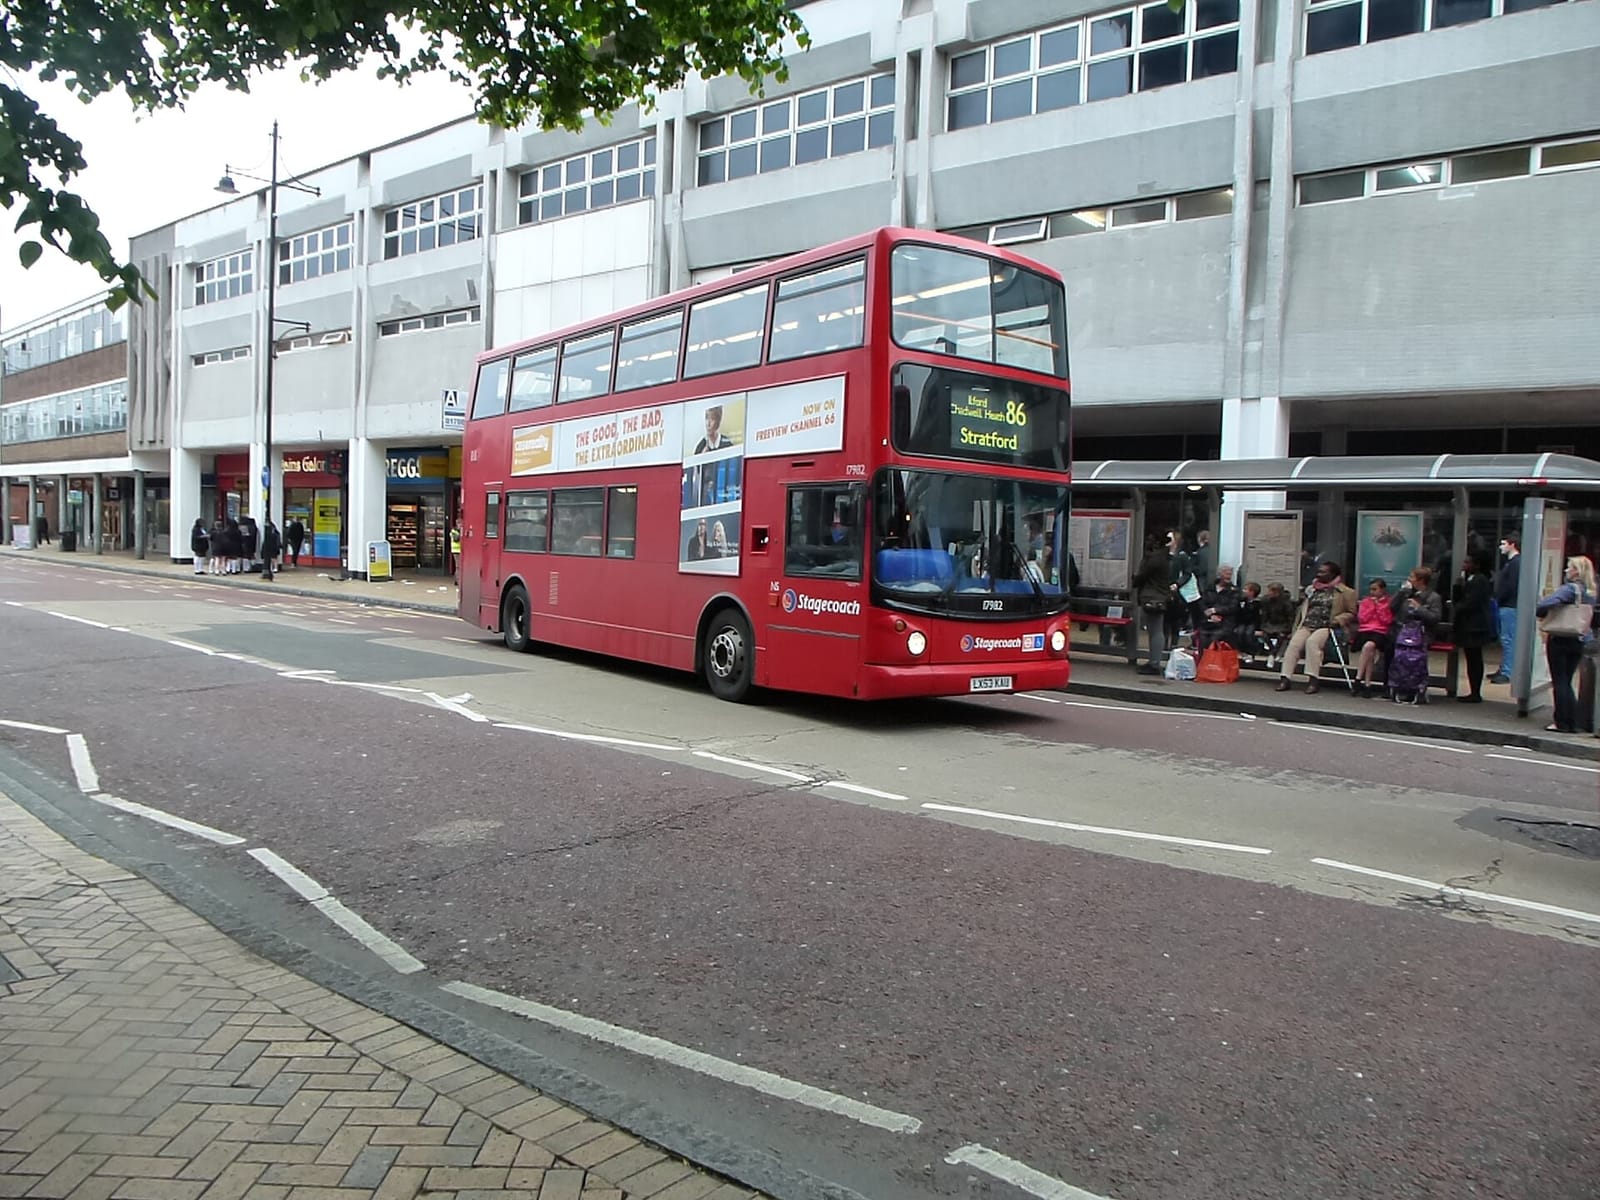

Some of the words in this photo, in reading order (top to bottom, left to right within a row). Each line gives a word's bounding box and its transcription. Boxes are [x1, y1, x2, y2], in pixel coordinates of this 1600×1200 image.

[803, 402, 821, 417] NOW
[824, 399, 836, 411] ON
[1006, 400, 1026, 426] 86
[576, 431, 590, 448] THE
[592, 422, 619, 443] GOOD,
[623, 417, 638, 435] THE
[641, 409, 664, 429] BAD,
[756, 424, 788, 441] FREEVIEW
[790, 416, 822, 433] CHANNEL
[960, 427, 1017, 450] Stratford
[575, 451, 589, 467] THE
[591, 430, 665, 463] EXTRAORDINARY
[846, 464, 866, 476] 17982
[770, 581, 780, 591] NS
[798, 594, 860, 615] Stagecoach
[982, 600, 1004, 611] 17982
[974, 637, 1021, 651] Stagecoach
